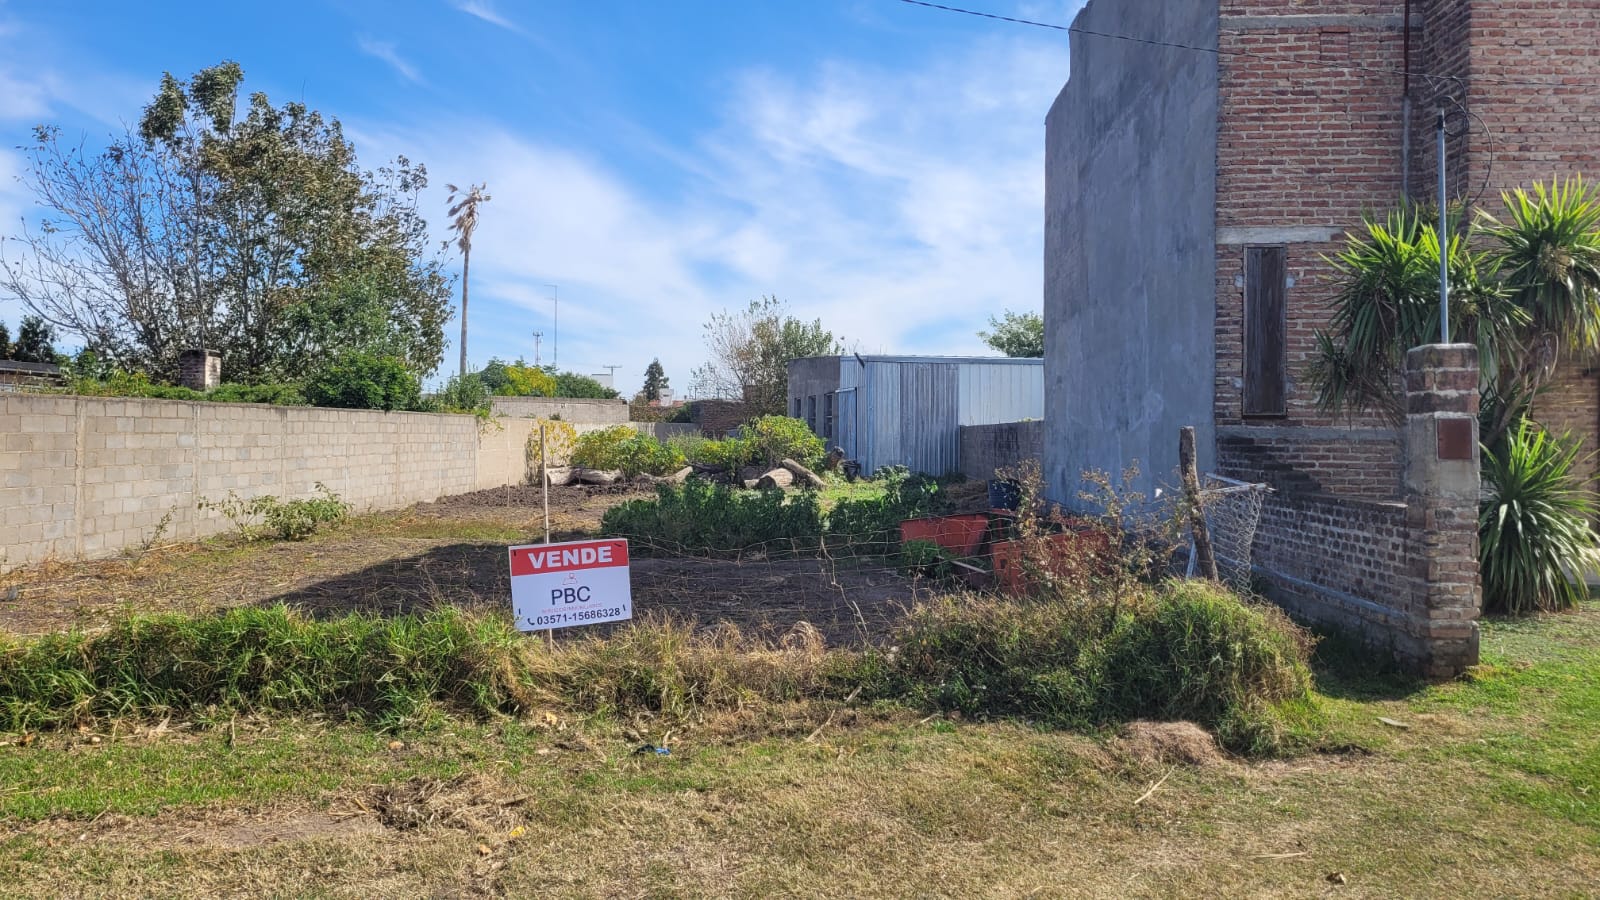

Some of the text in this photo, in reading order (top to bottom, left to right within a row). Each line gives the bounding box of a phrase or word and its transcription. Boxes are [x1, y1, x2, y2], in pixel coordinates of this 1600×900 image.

[528, 546, 613, 569] VENDE
[551, 586, 591, 605] PBC
[537, 608, 620, 625] 03571-15686328
